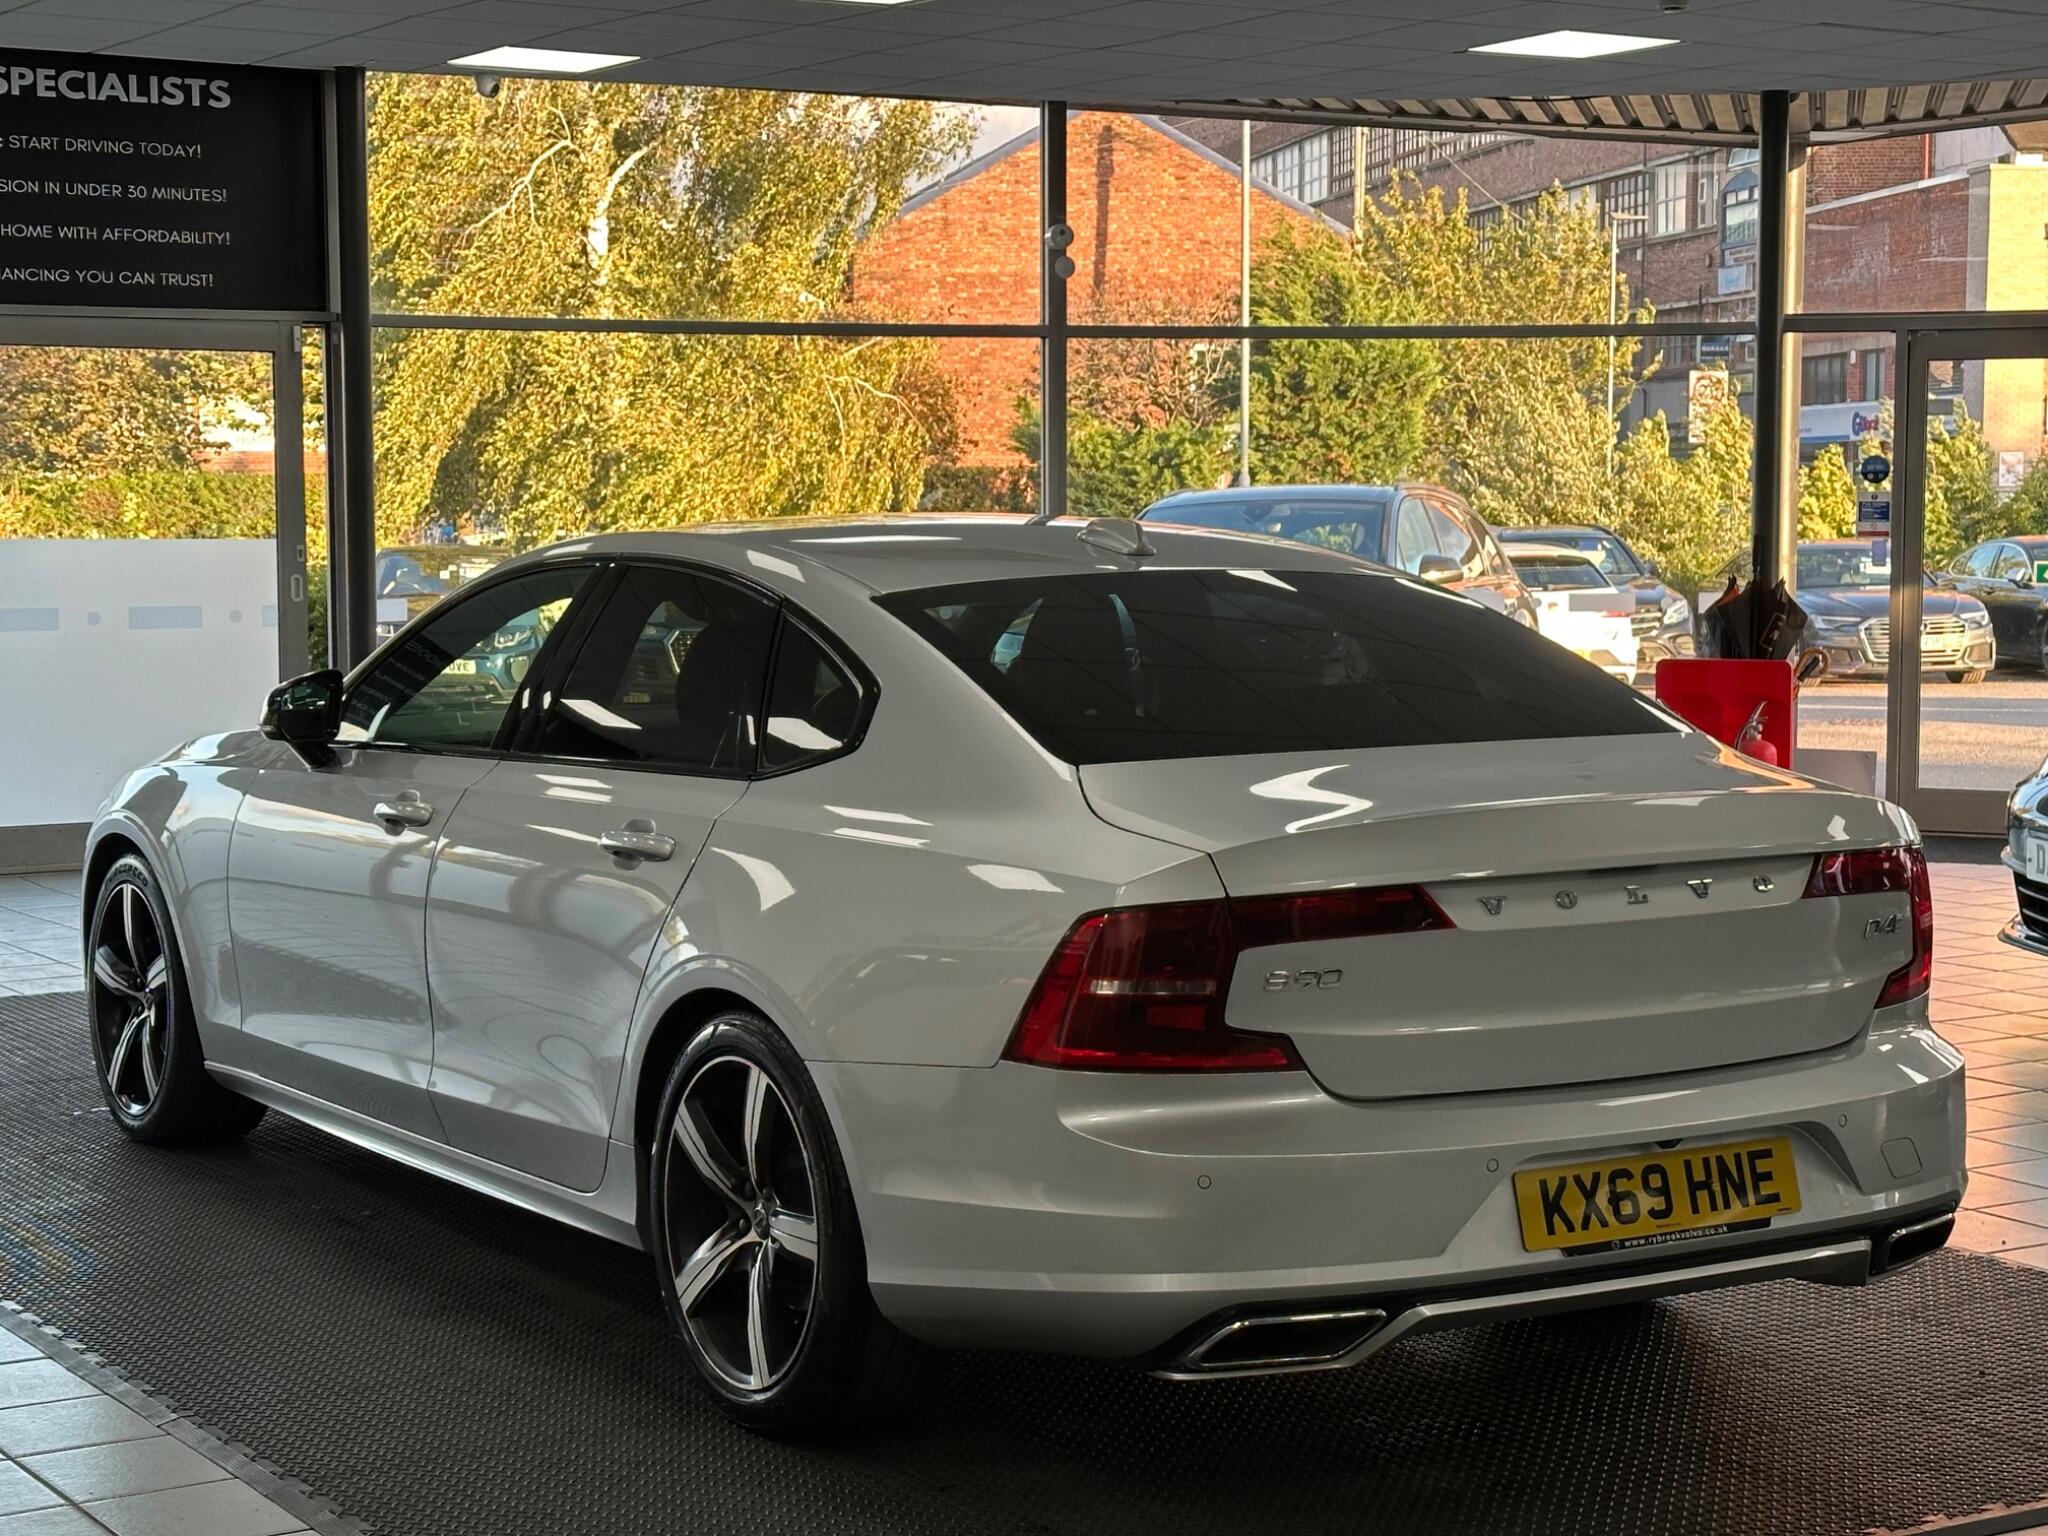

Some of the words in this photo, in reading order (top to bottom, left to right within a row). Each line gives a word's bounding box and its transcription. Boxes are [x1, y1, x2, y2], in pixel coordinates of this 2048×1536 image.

[8, 134, 60, 151] START
[64, 138, 134, 155] DRIVING
[139, 141, 202, 158] TODAY!
[44, 181, 60, 195] IN
[65, 182, 122, 198] UNDER
[127, 185, 147, 199] 30
[151, 187, 227, 203] MINUTES!
[0, 223, 53, 239] HOME
[57, 225, 97, 241] WITH
[102, 226, 231, 246] AFFORDABILITY!
[1, 267, 70, 283] ANCING
[75, 269, 114, 284] YOU
[118, 271, 155, 286] CAN
[160, 273, 214, 288] TRUST!
[1476, 874, 1775, 915] VOLVO
[1863, 914, 1902, 939] D4
[1263, 969, 1344, 993] S90
[1538, 1162, 1676, 1236] KX69
[1683, 1147, 1782, 1214] HNE
